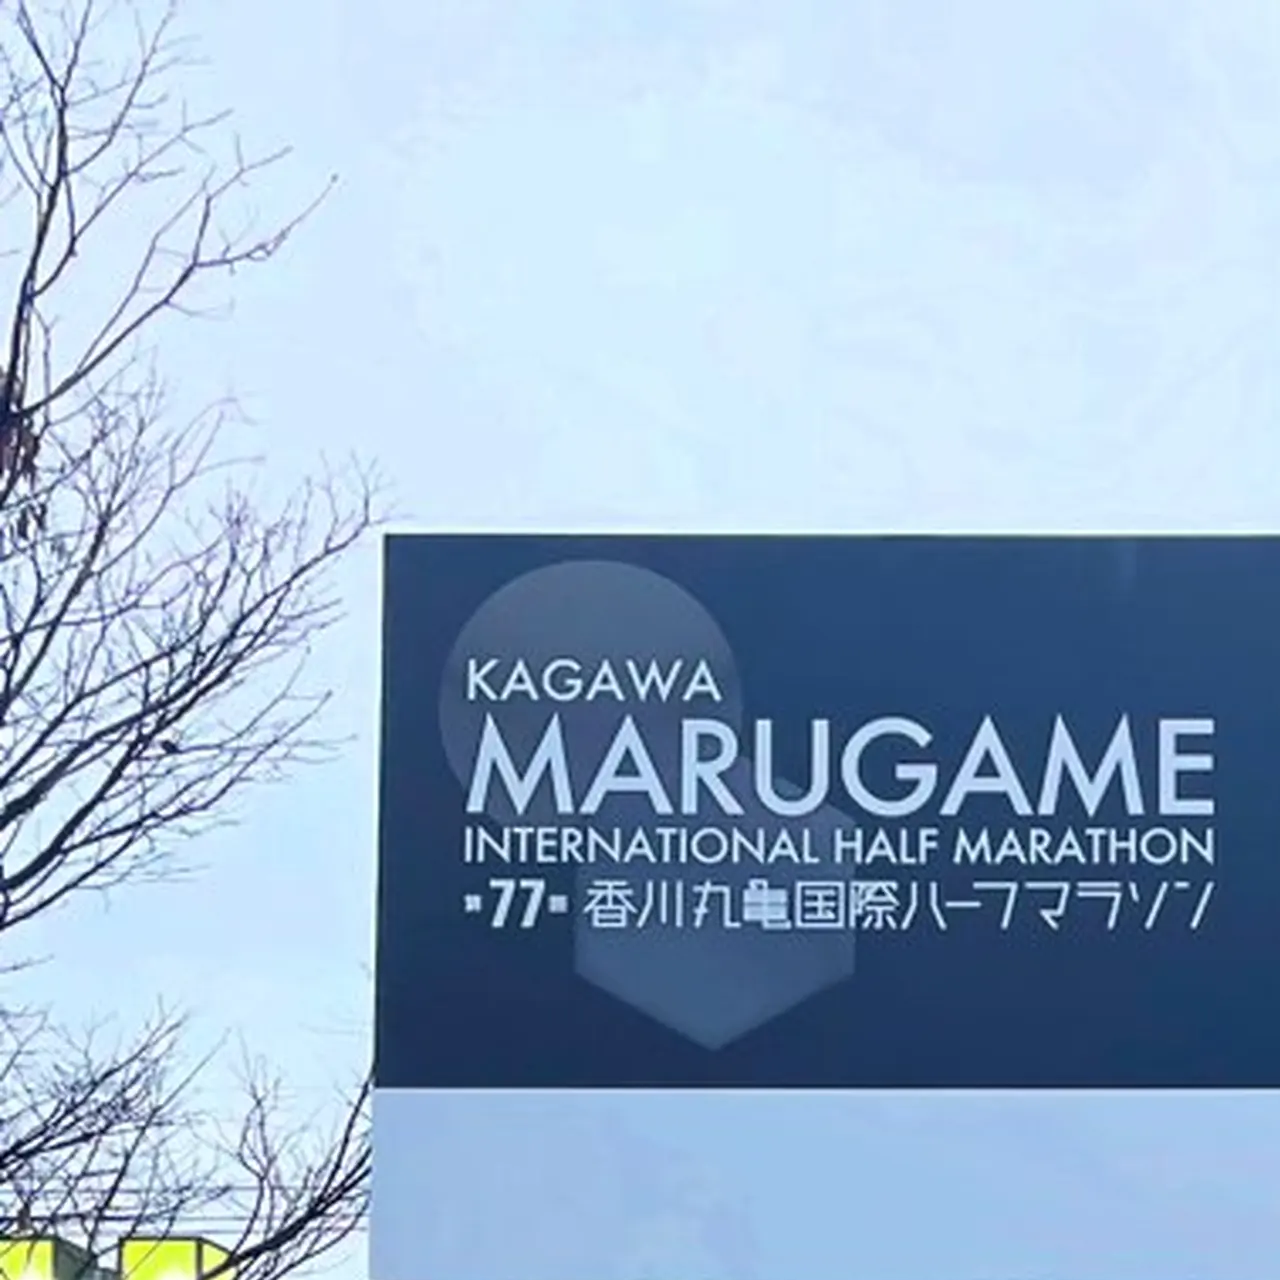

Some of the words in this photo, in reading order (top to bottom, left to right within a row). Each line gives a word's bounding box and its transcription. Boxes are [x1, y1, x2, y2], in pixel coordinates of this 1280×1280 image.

[467, 657, 722, 703] KAGAWA
[465, 714, 1216, 818] MARUGAME
[465, 825, 820, 866] INTERNATIONAL
[834, 825, 939, 866] HALF
[953, 825, 1215, 867] MARATHON
[464, 877, 568, 929] 77
[582, 877, 1215, 930] 香川丸亀国際ハーフマラソン
